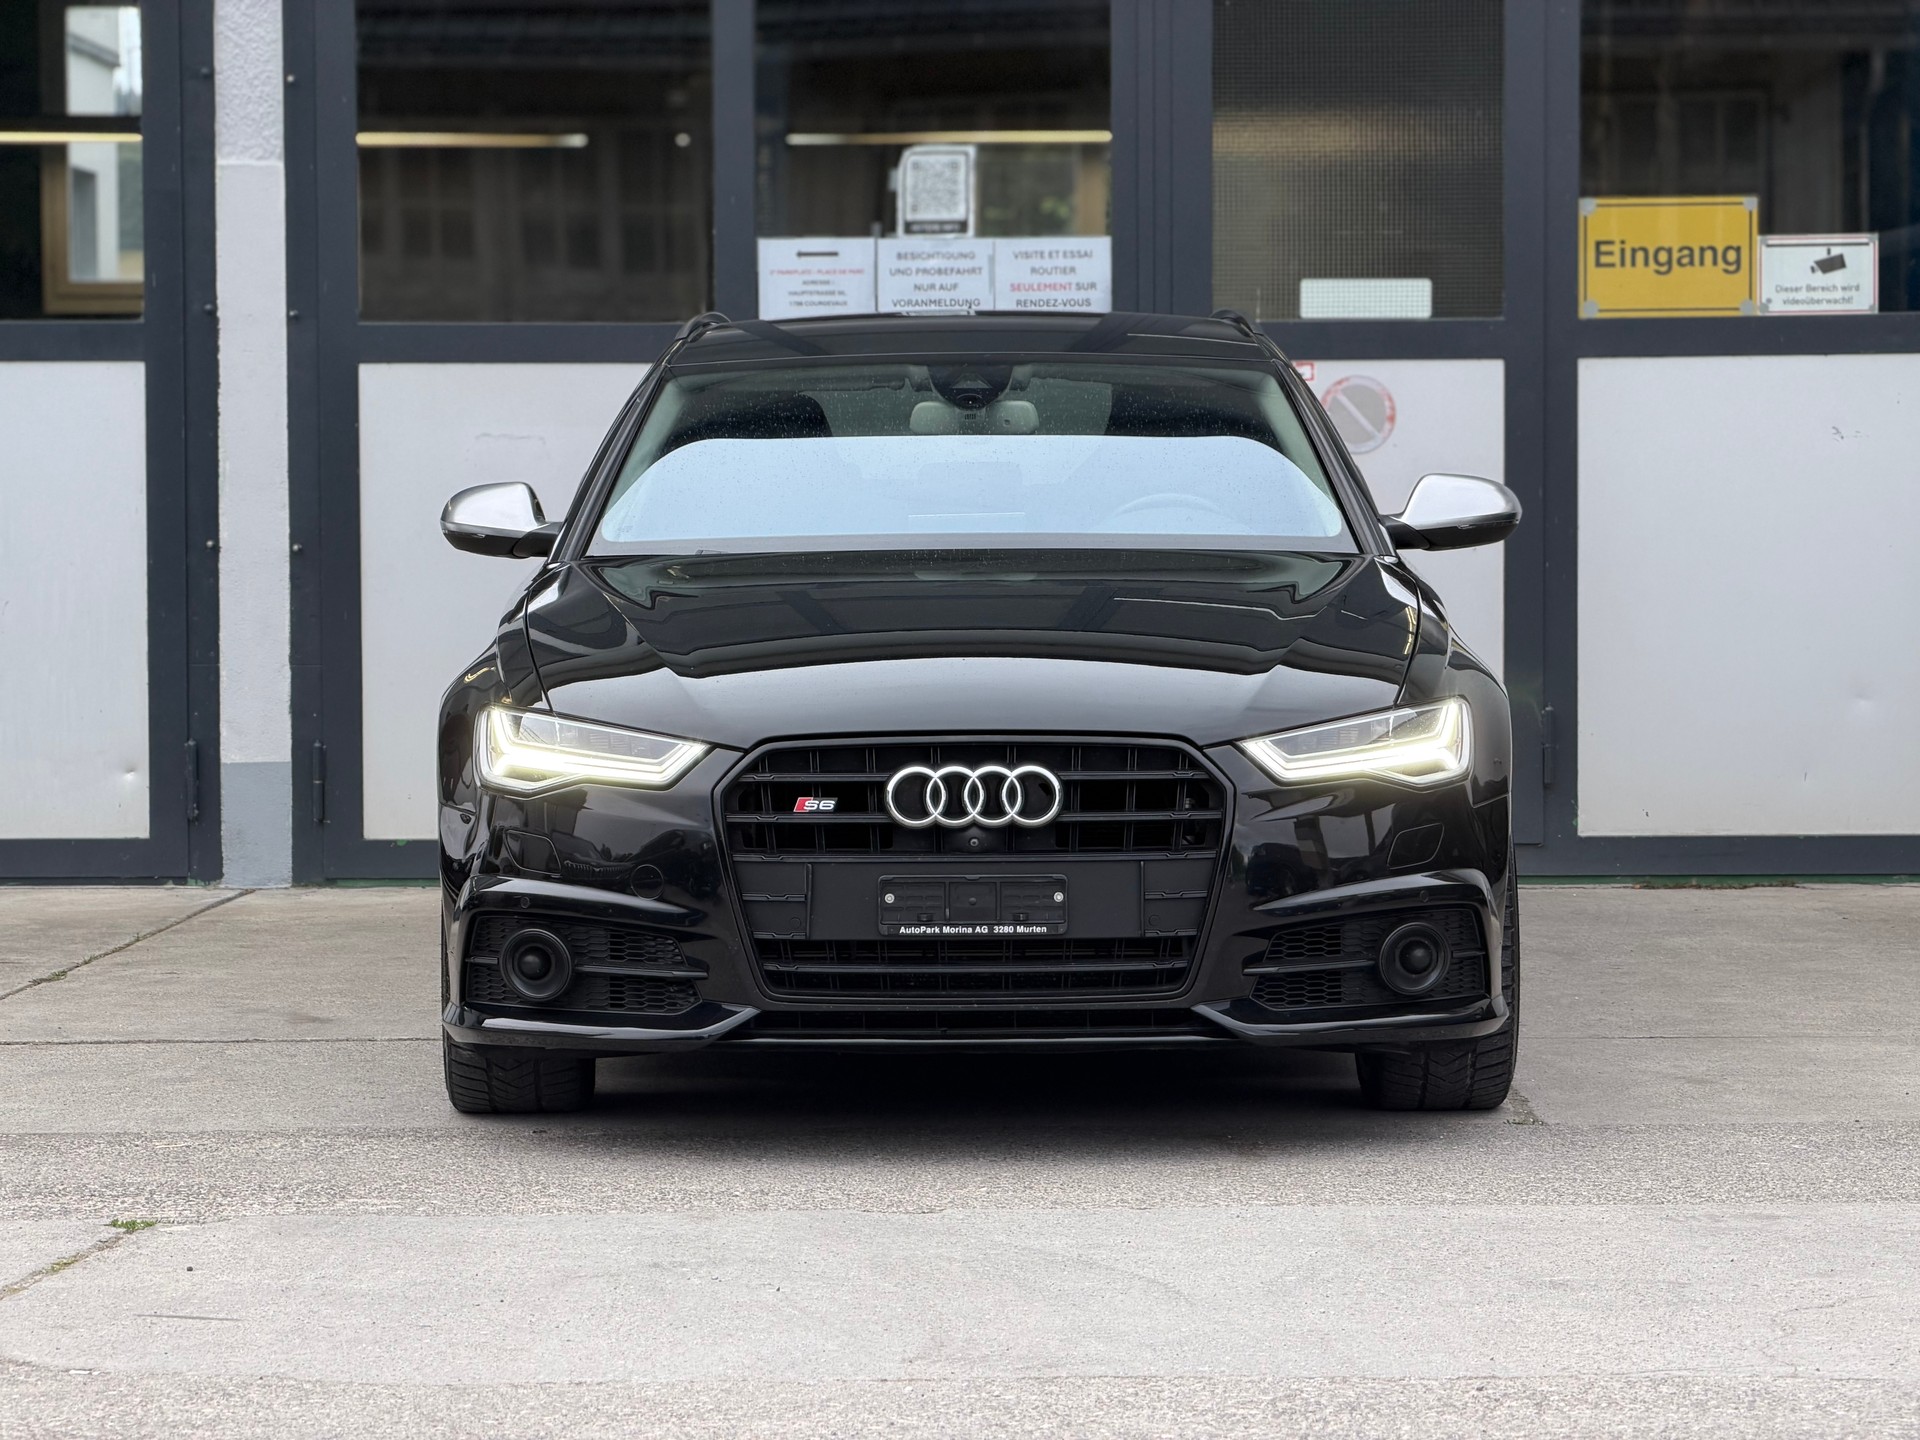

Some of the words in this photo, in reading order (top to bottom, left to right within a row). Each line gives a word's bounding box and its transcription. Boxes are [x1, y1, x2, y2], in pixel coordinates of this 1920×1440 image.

[896, 251, 976, 260] BESICHTIGUNG
[1013, 250, 1046, 260] VISITE
[1048, 250, 1060, 259] ET
[1062, 250, 1093, 259] ESSAI
[1594, 239, 1742, 276] Eingang
[889, 267, 913, 277] UND
[915, 266, 983, 276] PROBEFAHRT
[1030, 266, 1076, 276] ROUTIER
[914, 283, 937, 292] NUR
[938, 283, 959, 292] AUF
[1009, 282, 1073, 292] SEULEMENT
[1075, 281, 1098, 292] SUR
[1775, 285, 1804, 293] Dieser
[1806, 284, 1838, 292] Bereich
[892, 299, 981, 308] VORANMELDUNG
[1016, 299, 1092, 308] RENDEZ-VOUS
[1783, 296, 1854, 305] videoüberwacht!
[804, 800, 836, 810] S6
[899, 925, 940, 934] AutoPark
[943, 925, 973, 934] Morina
[975, 925, 989, 933] AG
[993, 925, 1014, 933] 3280
[1017, 925, 1047, 933] Murten
